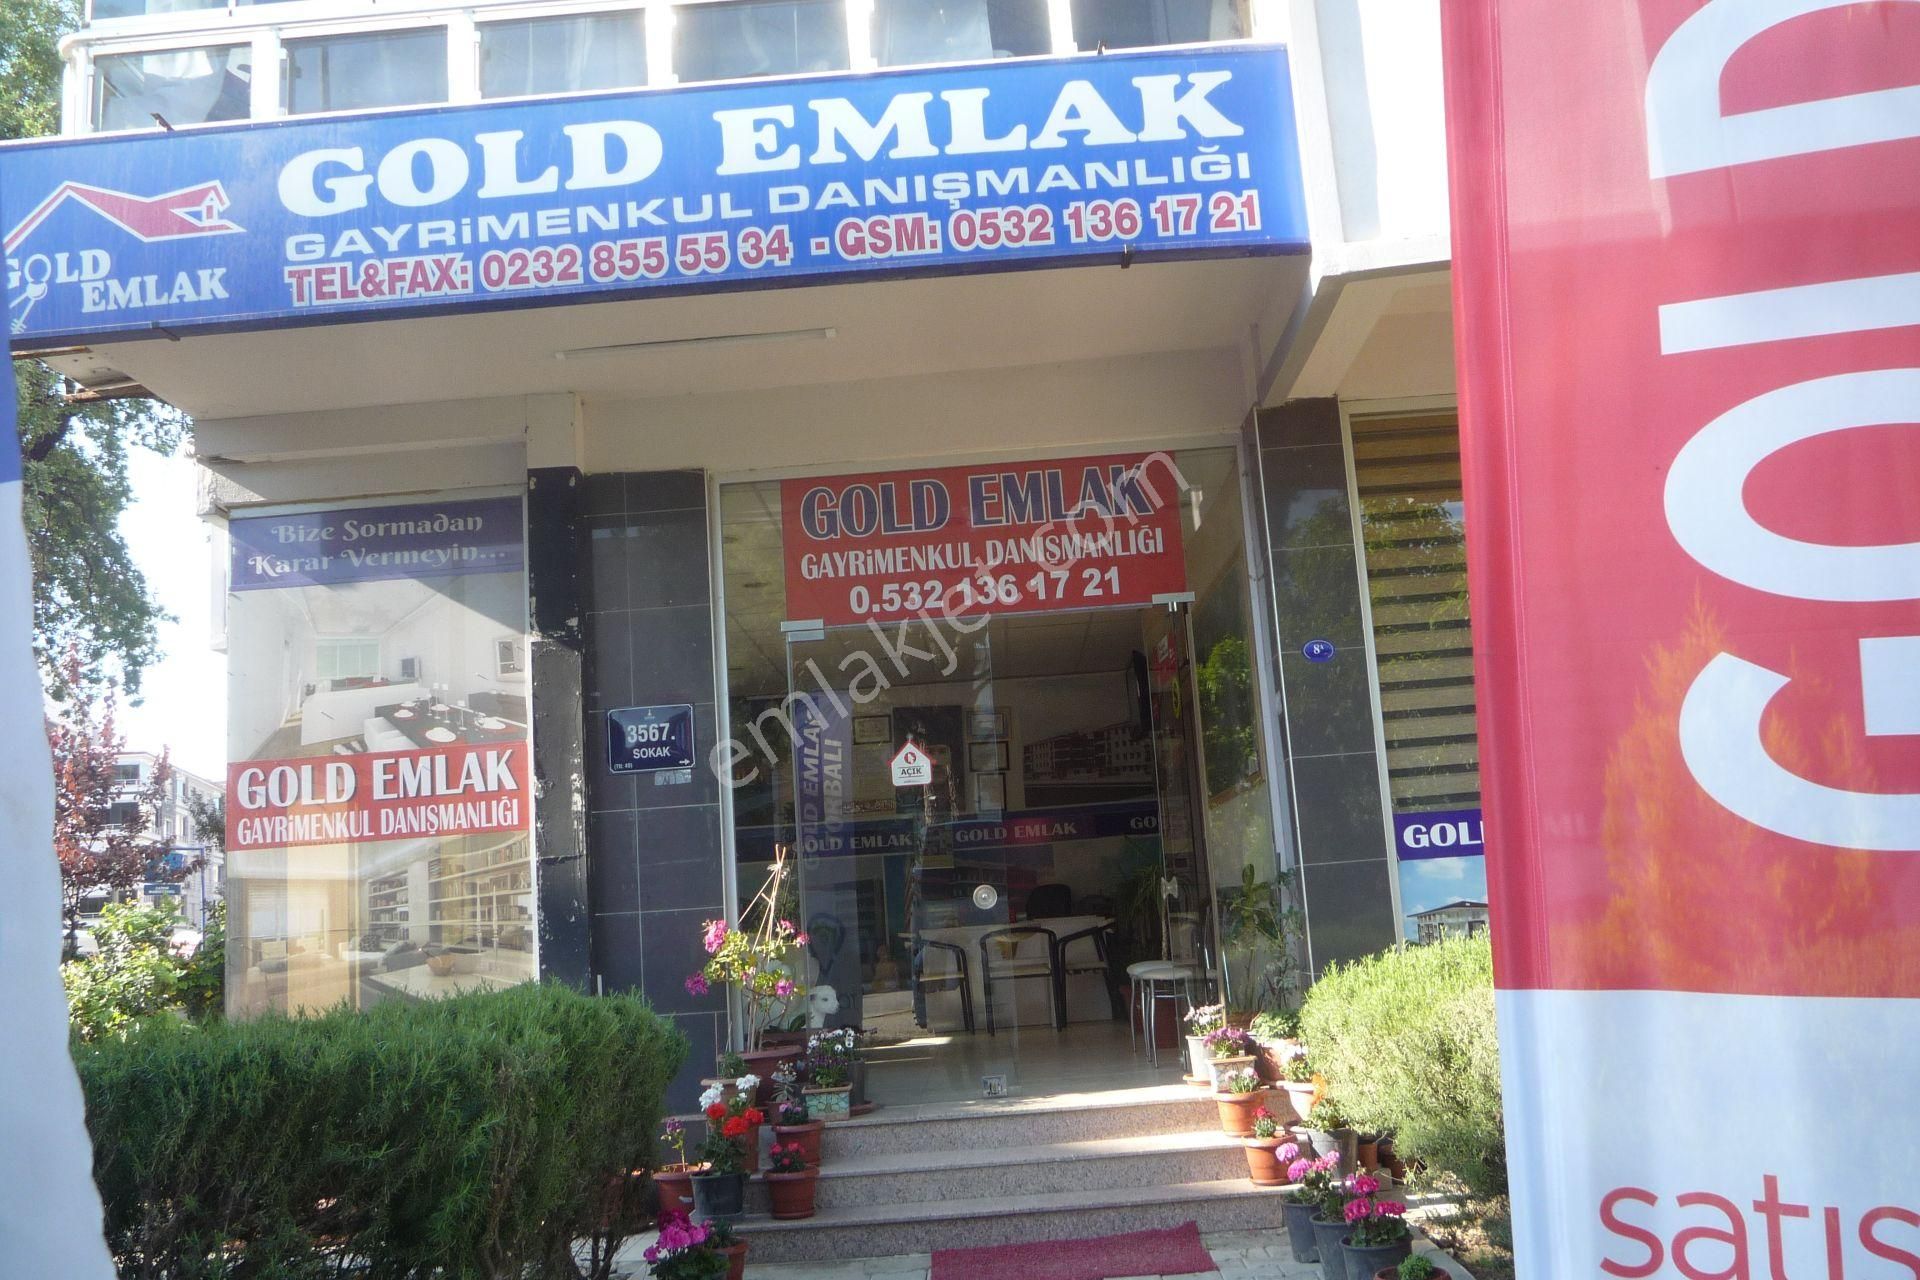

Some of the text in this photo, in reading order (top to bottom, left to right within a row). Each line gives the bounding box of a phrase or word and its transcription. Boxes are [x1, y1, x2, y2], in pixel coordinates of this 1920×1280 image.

[278, 71, 1244, 217] GOLD EMLAK
[770, 145, 1250, 212] DANIŞMANLIĞI
[286, 254, 472, 306] TEL&FAX:
[482, 245, 581, 293] 0232
[591, 238, 666, 282] 855
[675, 232, 729, 275] 55
[737, 225, 793, 268] 34
[837, 213, 941, 260] GSM:
[950, 203, 1053, 252] 0532
[1066, 198, 1140, 243] 136
[1151, 194, 1202, 237] 17
[1210, 190, 1260, 232] 21
[81, 267, 229, 313] EMLAK
[801, 463, 1154, 540] GOLD EMLAK
[271, 514, 483, 544] Bize Sormadan
[986, 525, 1164, 566] DANIŞMANLIĞI
[248, 543, 505, 577] Karar Vermeyin...
[850, 566, 1120, 613] 0.532 136 17 21
[627, 722, 676, 743] 3567.
[633, 746, 671, 759] SOKAK
[237, 749, 519, 809] GOLD EMLAK
[901, 767, 922, 777] AÇIK
[380, 797, 519, 835] DANIŞMANLIĞI
[956, 822, 1077, 842] GOLD EMLAK
[1403, 820, 1484, 849] GOL
[852, 833, 913, 850] EMLAK
